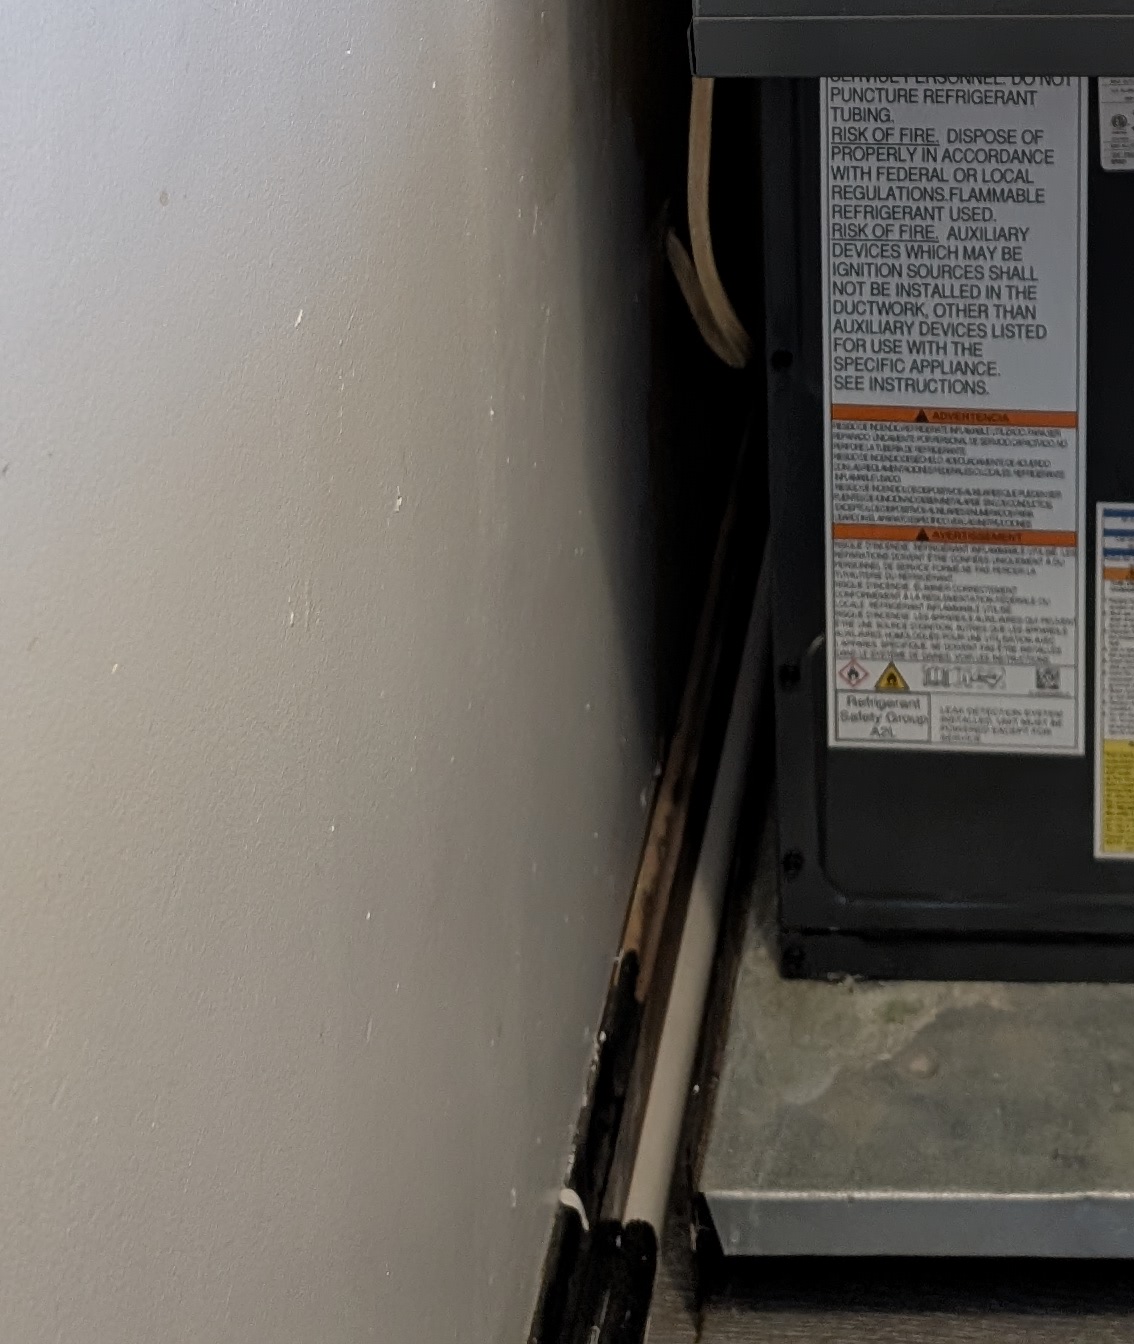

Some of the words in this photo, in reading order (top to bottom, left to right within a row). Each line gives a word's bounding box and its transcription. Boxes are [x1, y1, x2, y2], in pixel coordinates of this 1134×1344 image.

[831, 87, 918, 104] PUNCTURE
[924, 89, 1037, 106] REFRIGERANT
[832, 127, 868, 143] RISK
[872, 127, 895, 143] OF
[900, 128, 940, 144] FIRE.
[947, 128, 1016, 144] DISPOSE
[1021, 129, 1044, 145] OF
[832, 147, 918, 162] PROPERLY
[922, 148, 937, 163] IN
[942, 148, 1054, 165] ACCORDANCE
[831, 166, 871, 181] WITH
[877, 167, 949, 183] FEDERAL
[953, 168, 978, 183] OR
[982, 169, 1034, 184] LOCAL
[832, 205, 945, 221] REFRIGERANT
[949, 206, 997, 222] USED.
[832, 223, 868, 238] RISK
[872, 224, 894, 239] OF
[899, 224, 938, 240] FIRE.
[947, 226, 1029, 241] AUXILIARY
[832, 243, 900, 259] DEVICES
[905, 245, 959, 260] WHICH
[963, 246, 997, 261] MAY
[1001, 247, 1022, 261] BE
[833, 262, 902, 278] IGNITION
[907, 264, 985, 280] SOURCES
[989, 266, 1038, 281] SHALL
[833, 282, 866, 297] NOT
[871, 283, 890, 297] BE
[896, 283, 981, 300] INSTALLED
[986, 285, 1001, 300] IN
[1005, 285, 1037, 301] THE
[933, 303, 989, 319] OTHER
[993, 304, 1036, 320] THAN
[833, 319, 915, 335] AUXILIARY
[919, 322, 987, 338] DEVICES
[992, 323, 1047, 340] LISTED
[833, 338, 866, 354] FOR
[871, 339, 902, 355] USE
[906, 340, 948, 356] WITH
[951, 341, 983, 357] THE
[833, 357, 905, 373] SPECIFIC
[909, 360, 1001, 376] APPLIANCE.
[834, 376, 864, 391] SEE
[869, 377, 990, 395] INSTRUCTIONS.
